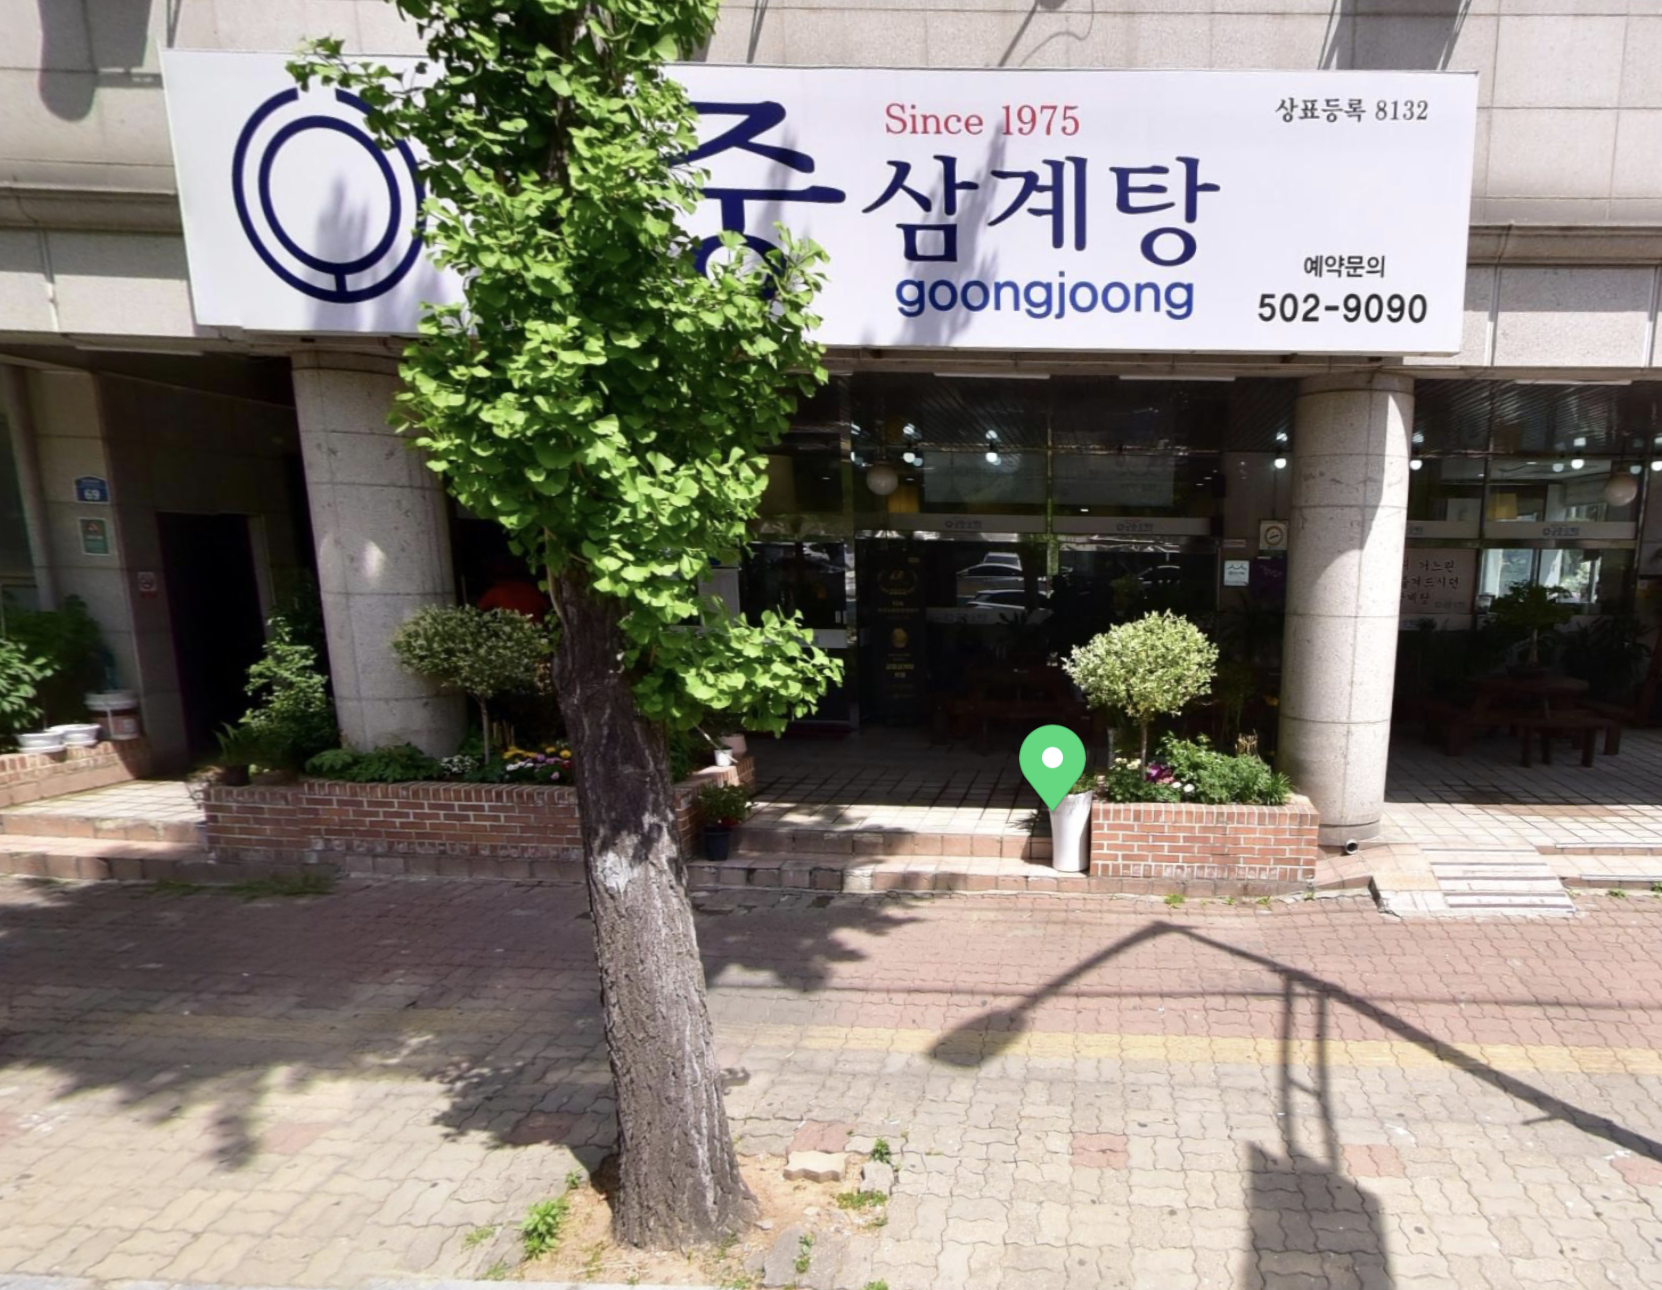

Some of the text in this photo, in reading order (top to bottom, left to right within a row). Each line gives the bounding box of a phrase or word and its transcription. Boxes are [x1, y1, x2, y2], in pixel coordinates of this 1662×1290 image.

[885, 102, 1080, 135] Since 1975
[1276, 97, 1429, 123] 상표등록 8132
[862, 155, 1220, 265] 삼계탕
[1303, 255, 1386, 279] 예약문의
[896, 271, 1193, 321] goongjoong
[1258, 292, 1428, 324] 502-9090
